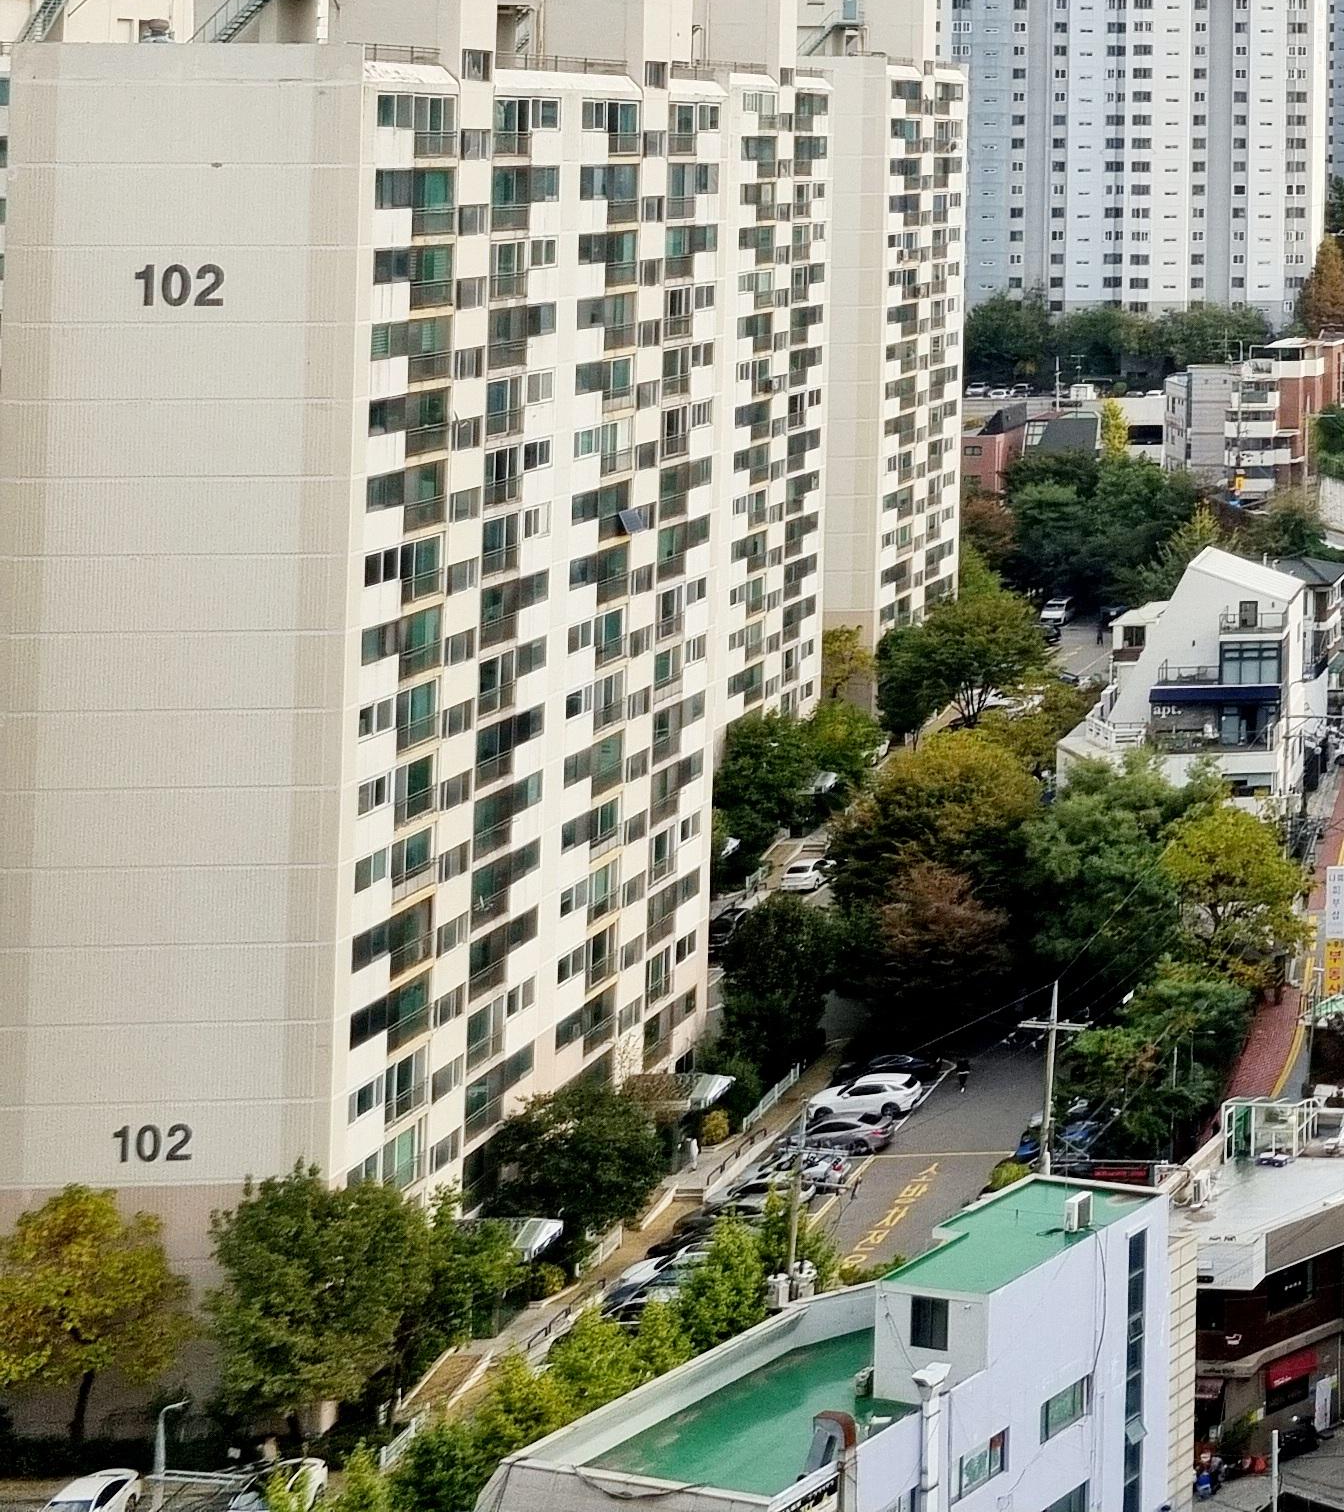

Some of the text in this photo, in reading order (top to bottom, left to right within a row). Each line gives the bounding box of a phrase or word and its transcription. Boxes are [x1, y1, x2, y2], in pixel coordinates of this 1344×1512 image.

[134, 263, 225, 307] 102
[1153, 705, 1182, 719] apt.
[112, 1123, 193, 1163] 102
